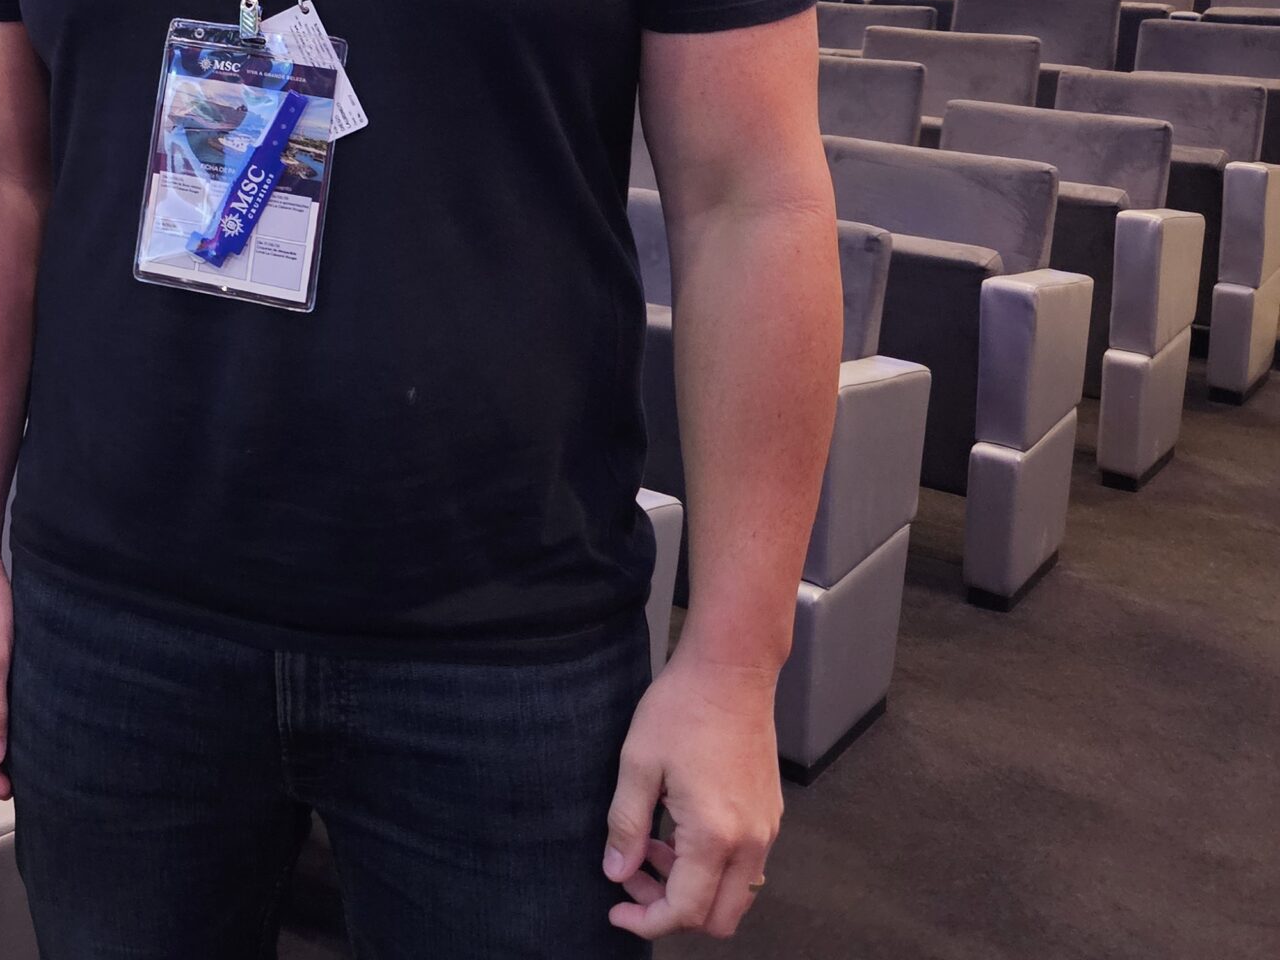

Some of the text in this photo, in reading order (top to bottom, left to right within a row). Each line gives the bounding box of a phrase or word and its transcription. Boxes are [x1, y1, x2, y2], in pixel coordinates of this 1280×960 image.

[213, 59, 241, 73] MSC
[236, 164, 265, 215] MSC
[247, 173, 274, 219] CRUZEIROS
